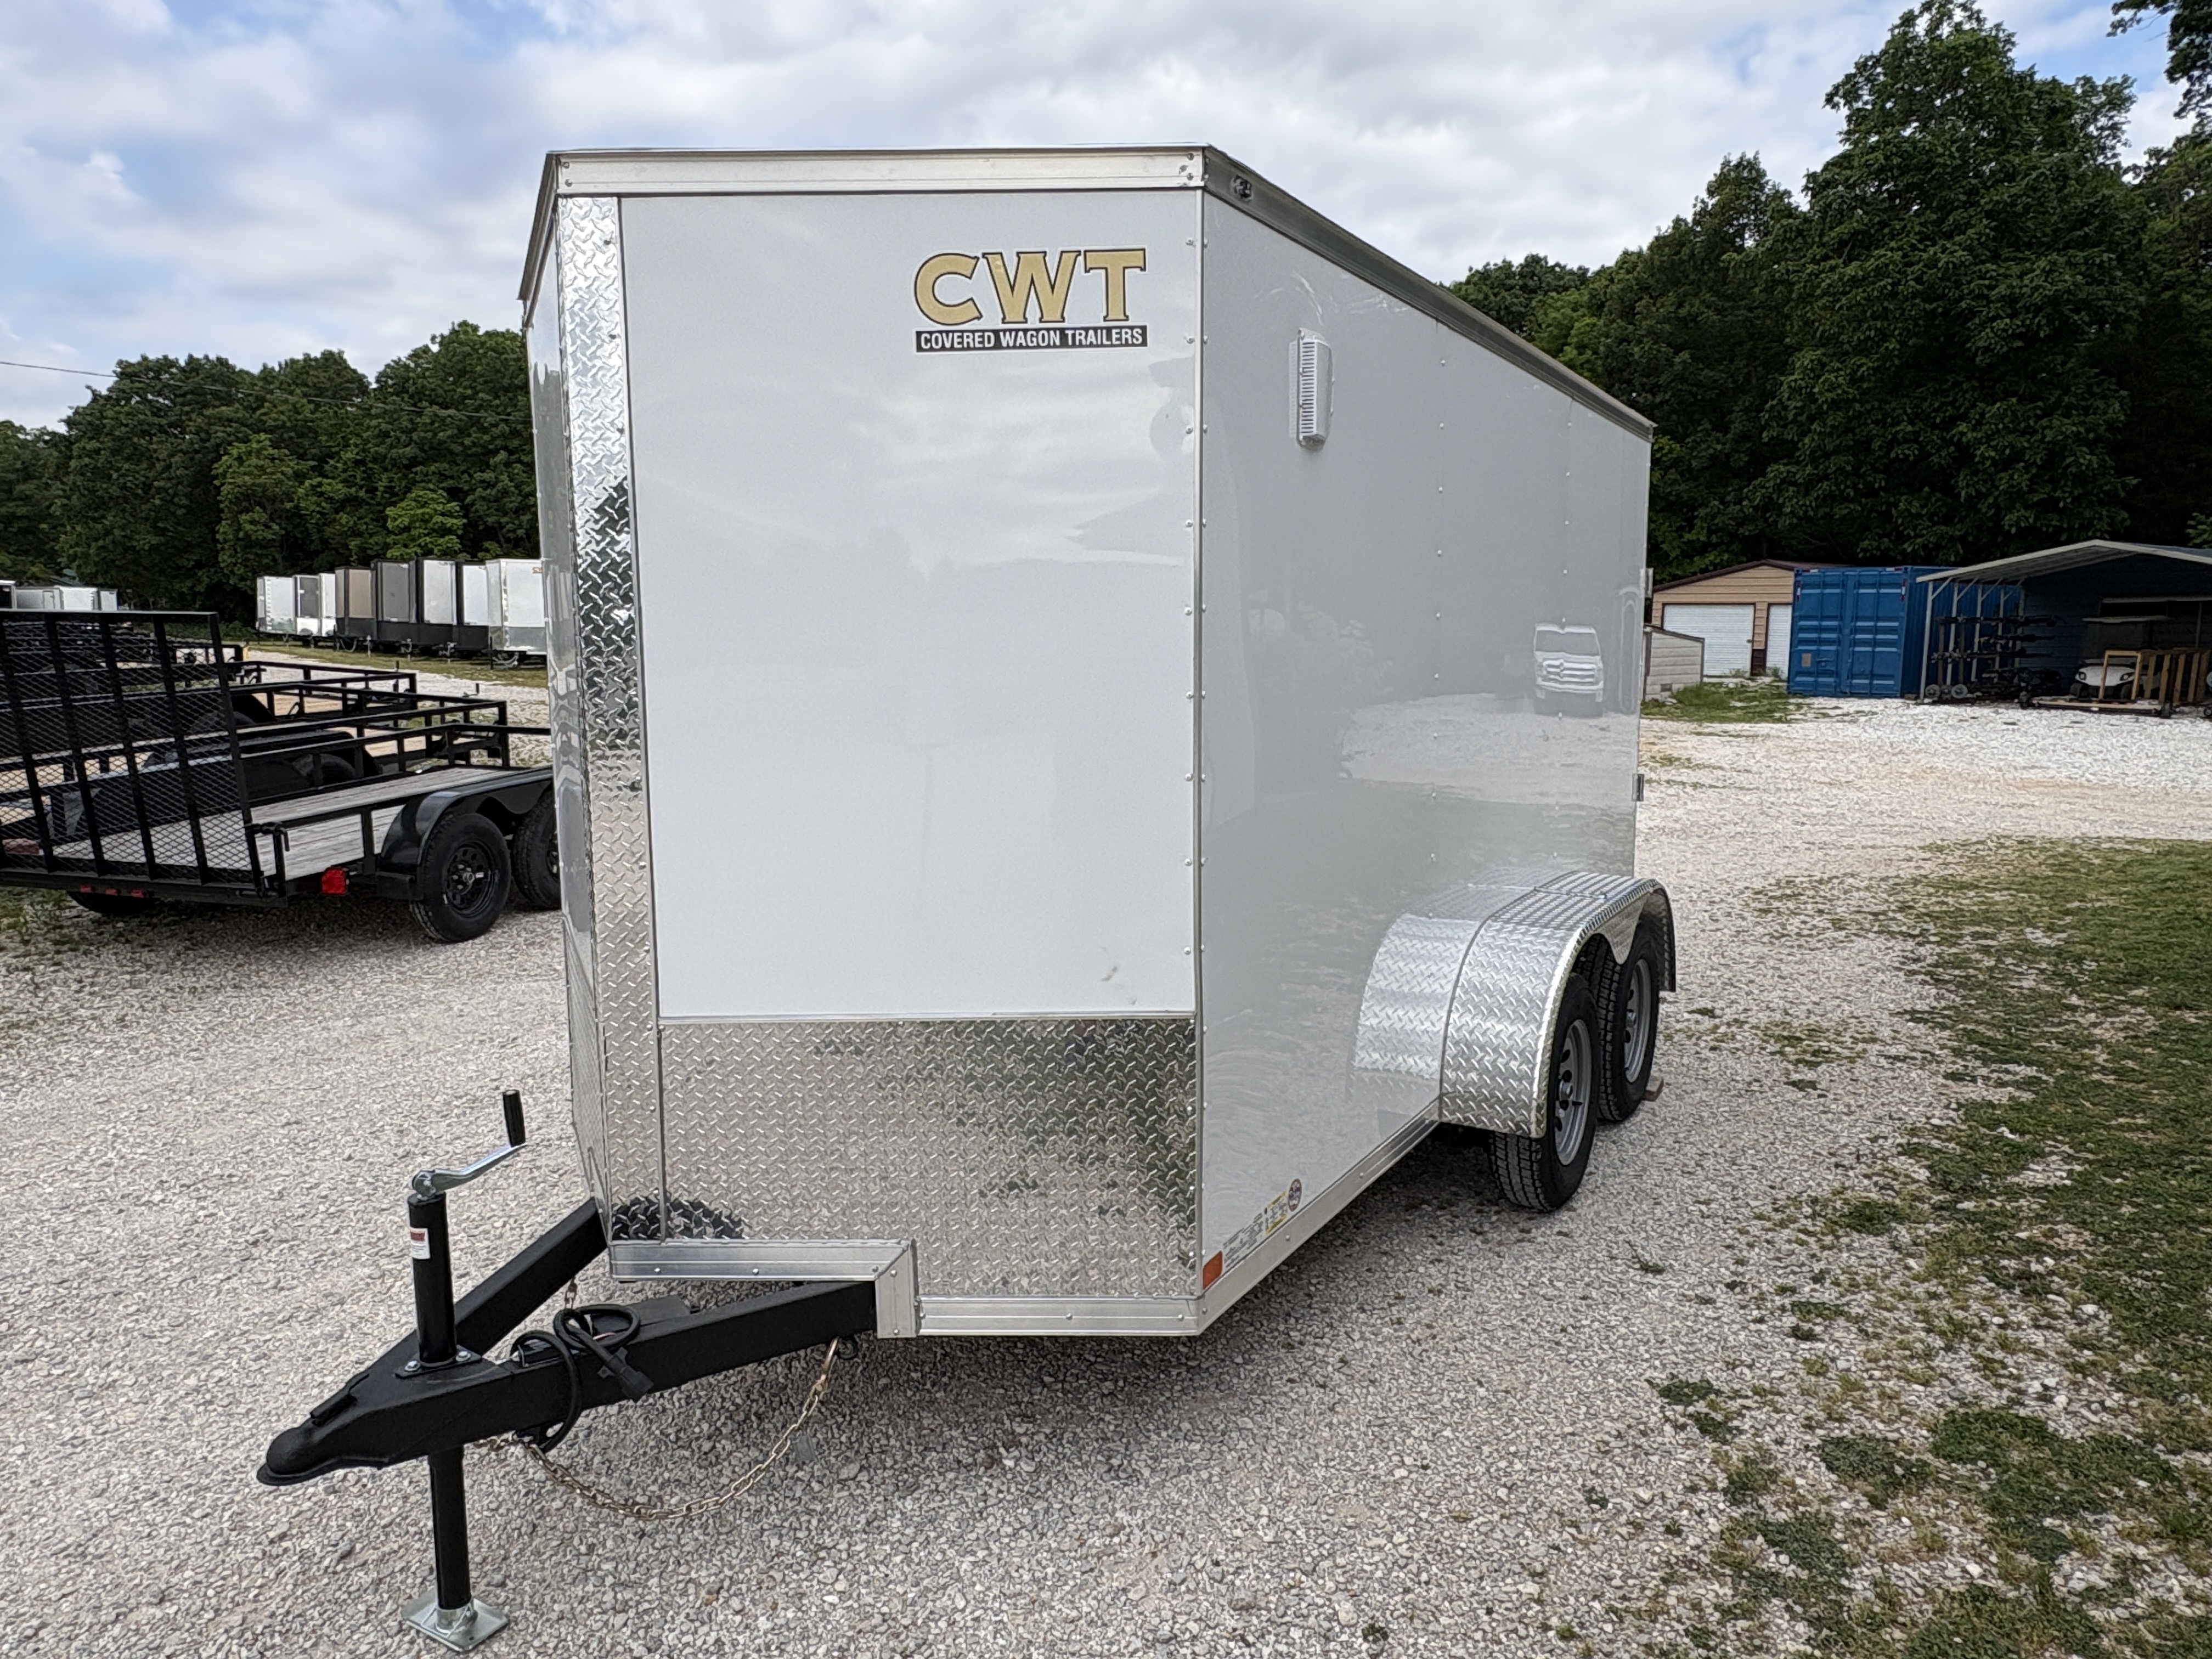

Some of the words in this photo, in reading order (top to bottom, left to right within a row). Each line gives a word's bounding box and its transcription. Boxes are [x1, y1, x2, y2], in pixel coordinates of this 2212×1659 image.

[914, 249, 1147, 326] CWT
[921, 331, 995, 349] COVERED
[1000, 330, 1061, 348] WAGON
[1065, 328, 1142, 346] TRAILERS
